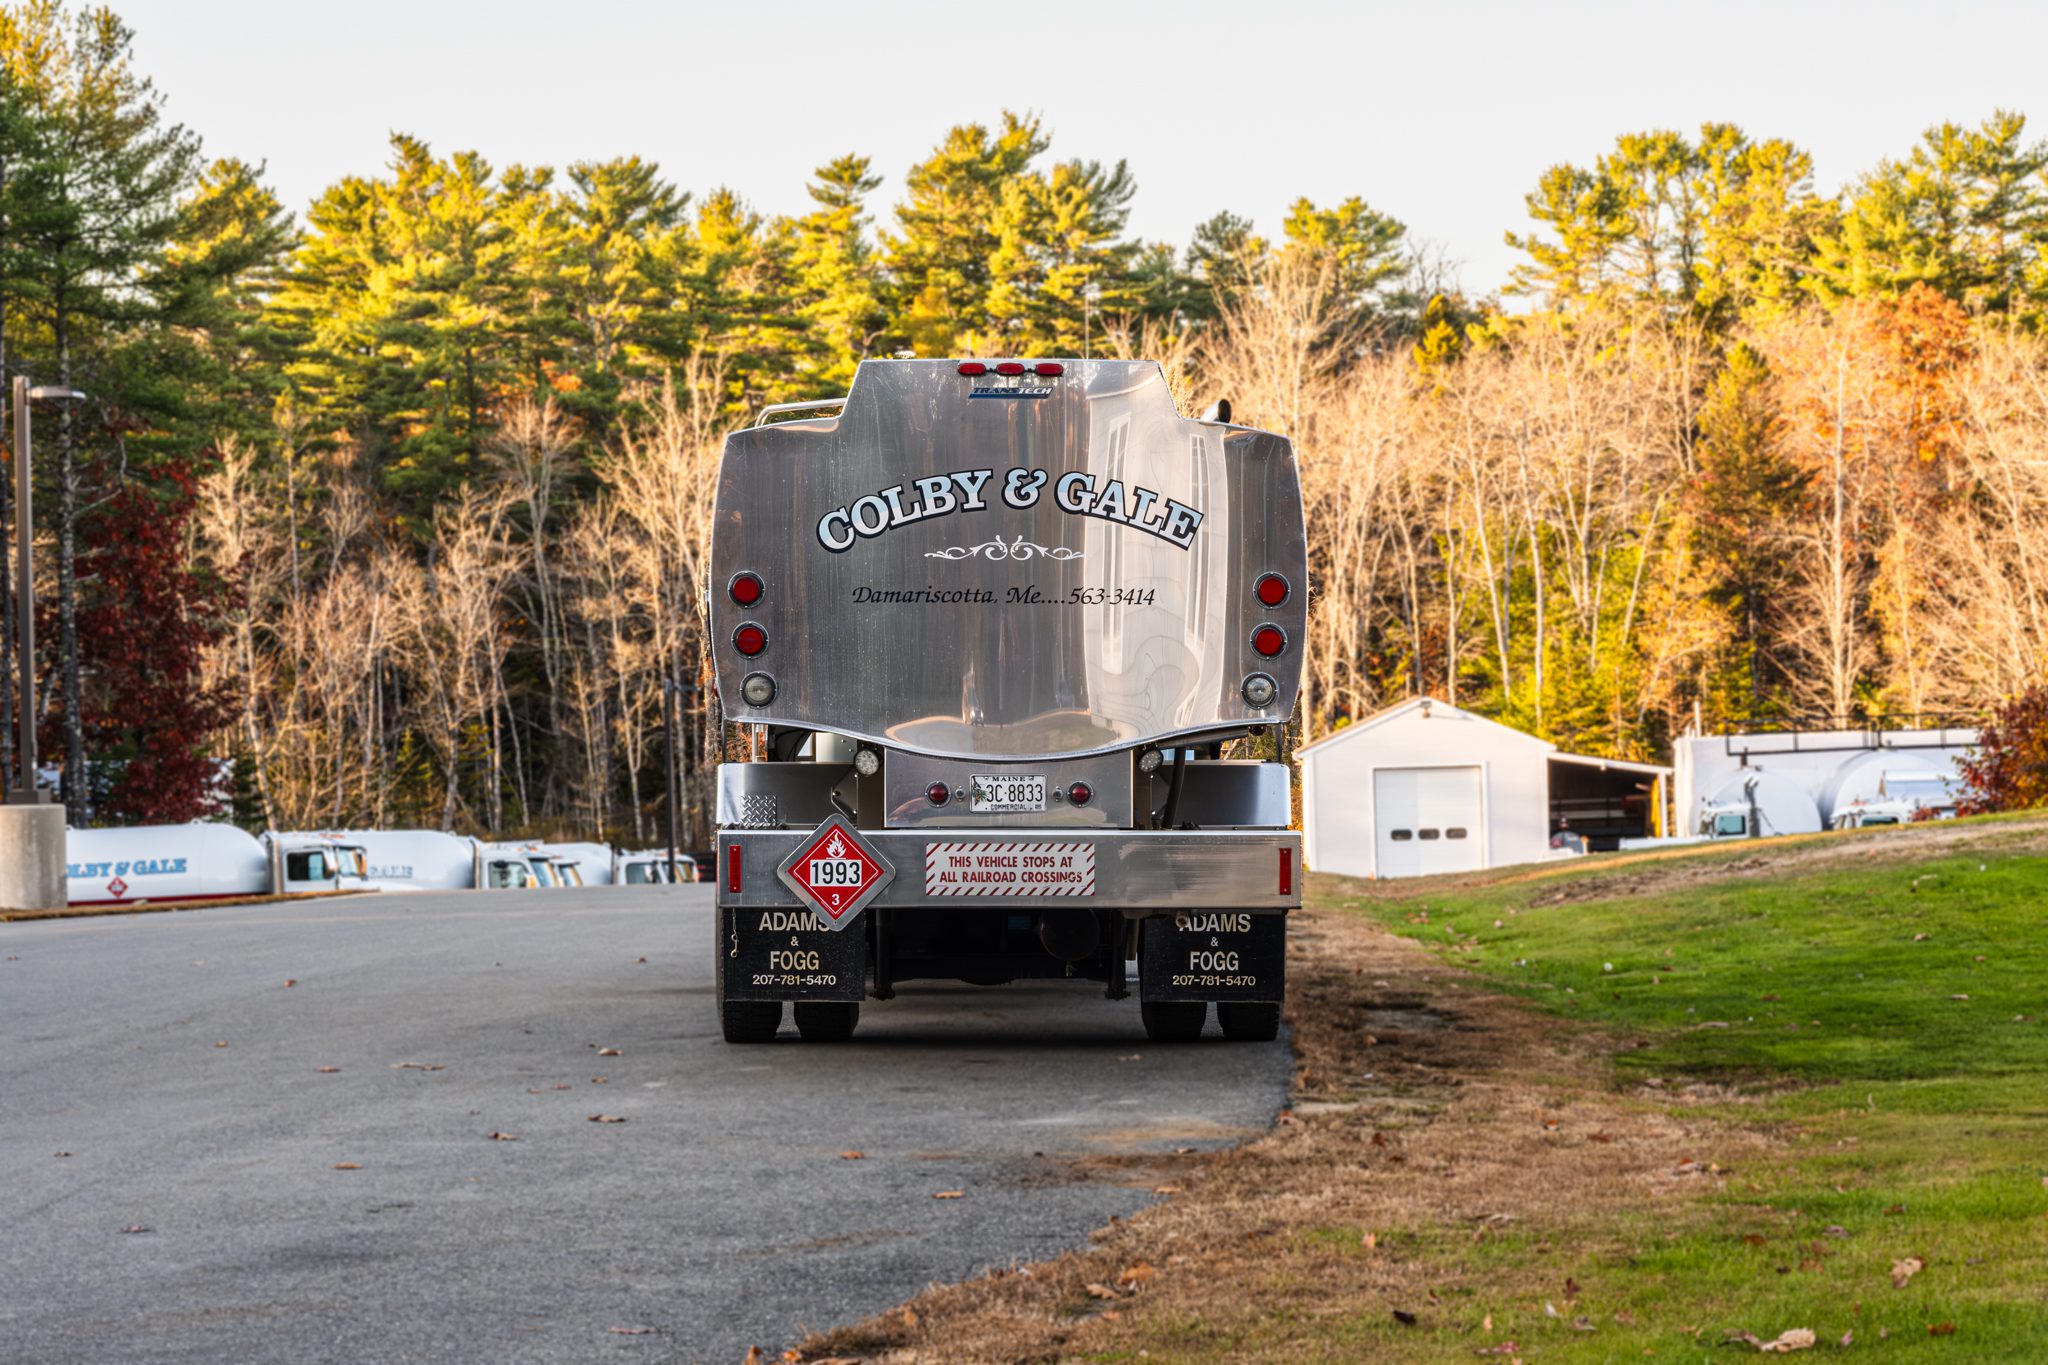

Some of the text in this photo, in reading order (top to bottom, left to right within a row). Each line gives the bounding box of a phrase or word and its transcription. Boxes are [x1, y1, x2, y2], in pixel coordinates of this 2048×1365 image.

[816, 467, 1204, 554] COLBY & GALE
[852, 585, 998, 604] Damariscotta,
[132, 858, 187, 875] GALE
[949, 856, 1073, 868] THIS VEHICLE STOPS AT
[811, 861, 861, 885] 1993
[939, 872, 1083, 883] ALL RAILROAD CROSSINGS
[831, 893, 840, 906] 3
[790, 936, 799, 946] &
[1210, 936, 1219, 947] &
[770, 951, 820, 971] FOGG
[1189, 951, 1239, 971] FOGG
[752, 974, 837, 986] 207-781-5470
[1172, 975, 1256, 986] 207-781-5470
